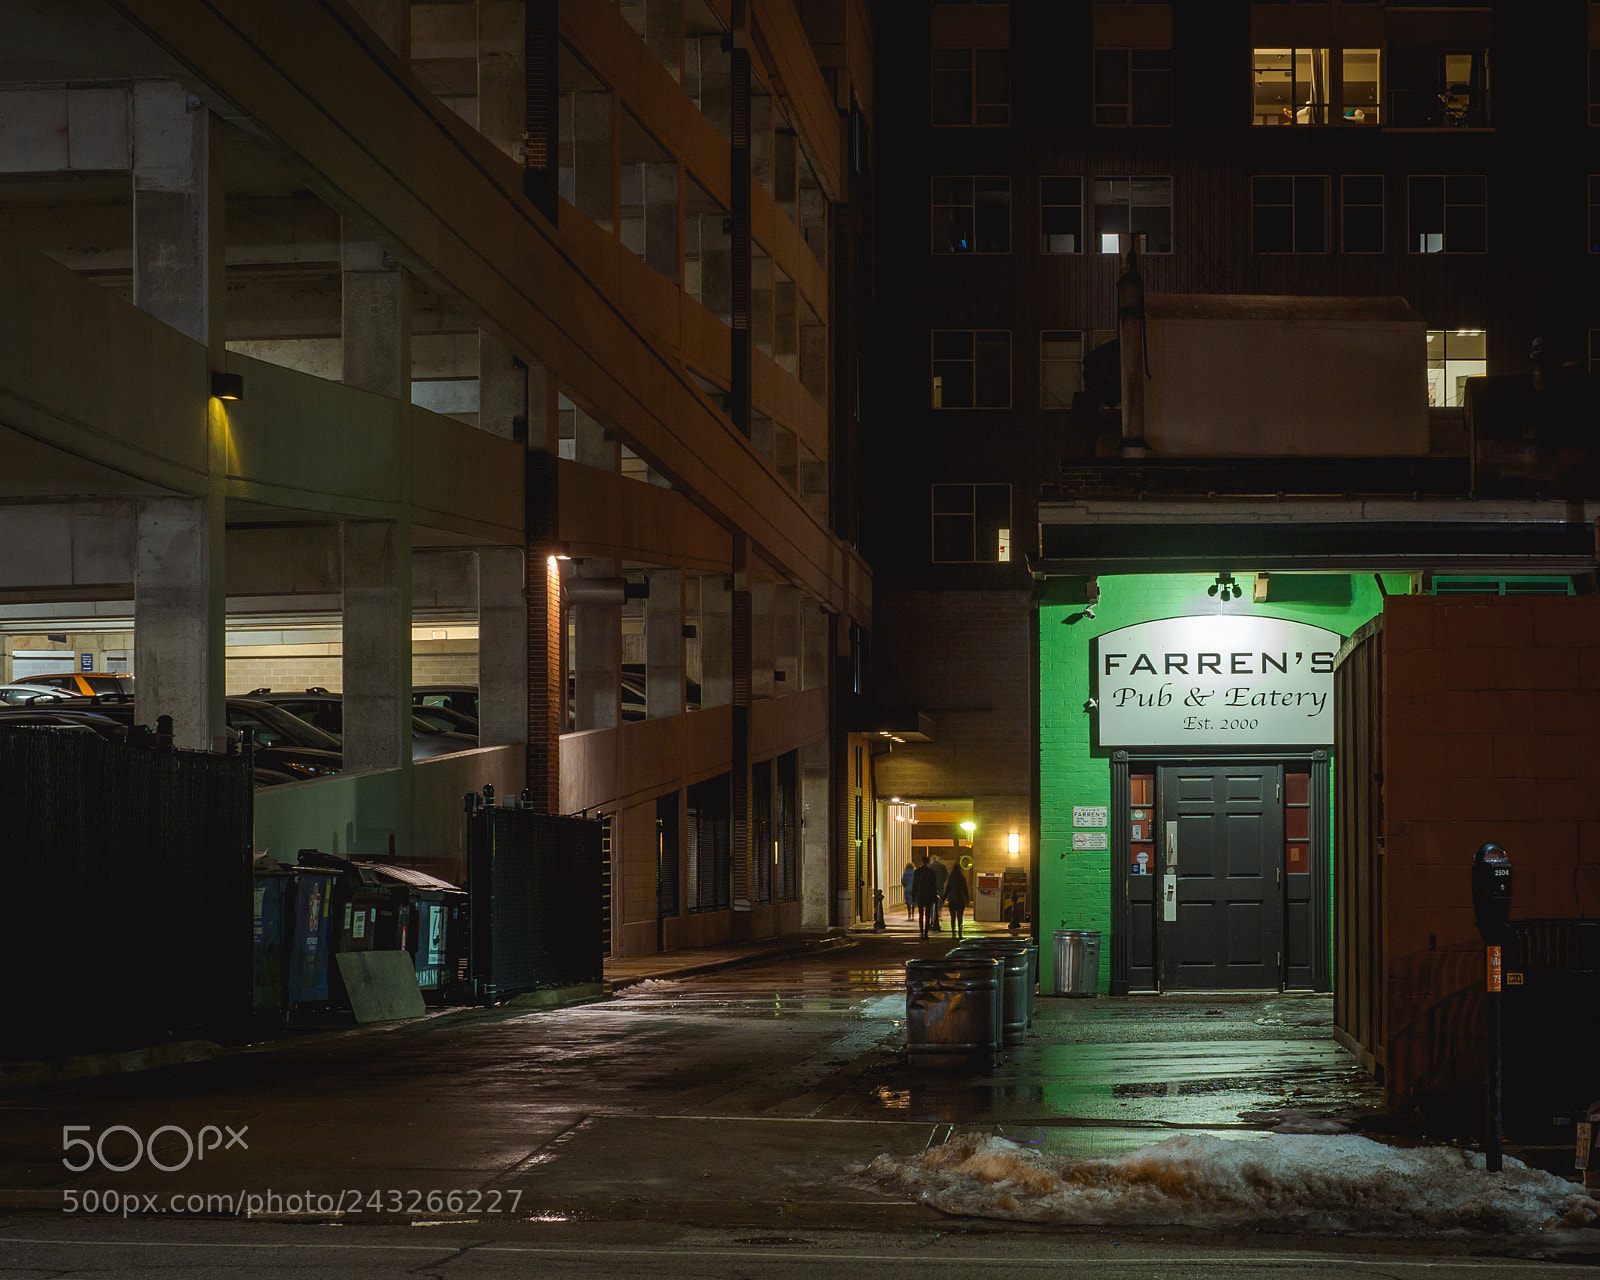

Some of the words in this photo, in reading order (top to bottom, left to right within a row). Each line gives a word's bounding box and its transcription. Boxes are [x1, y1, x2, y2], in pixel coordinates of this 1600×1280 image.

[1104, 651, 1335, 676] FARREN'S
[1112, 682, 1174, 708] Pub
[1183, 686, 1215, 707] &
[1225, 687, 1328, 717] Eatery
[1183, 716, 1214, 730] Est.
[1219, 717, 1259, 730] 2000
